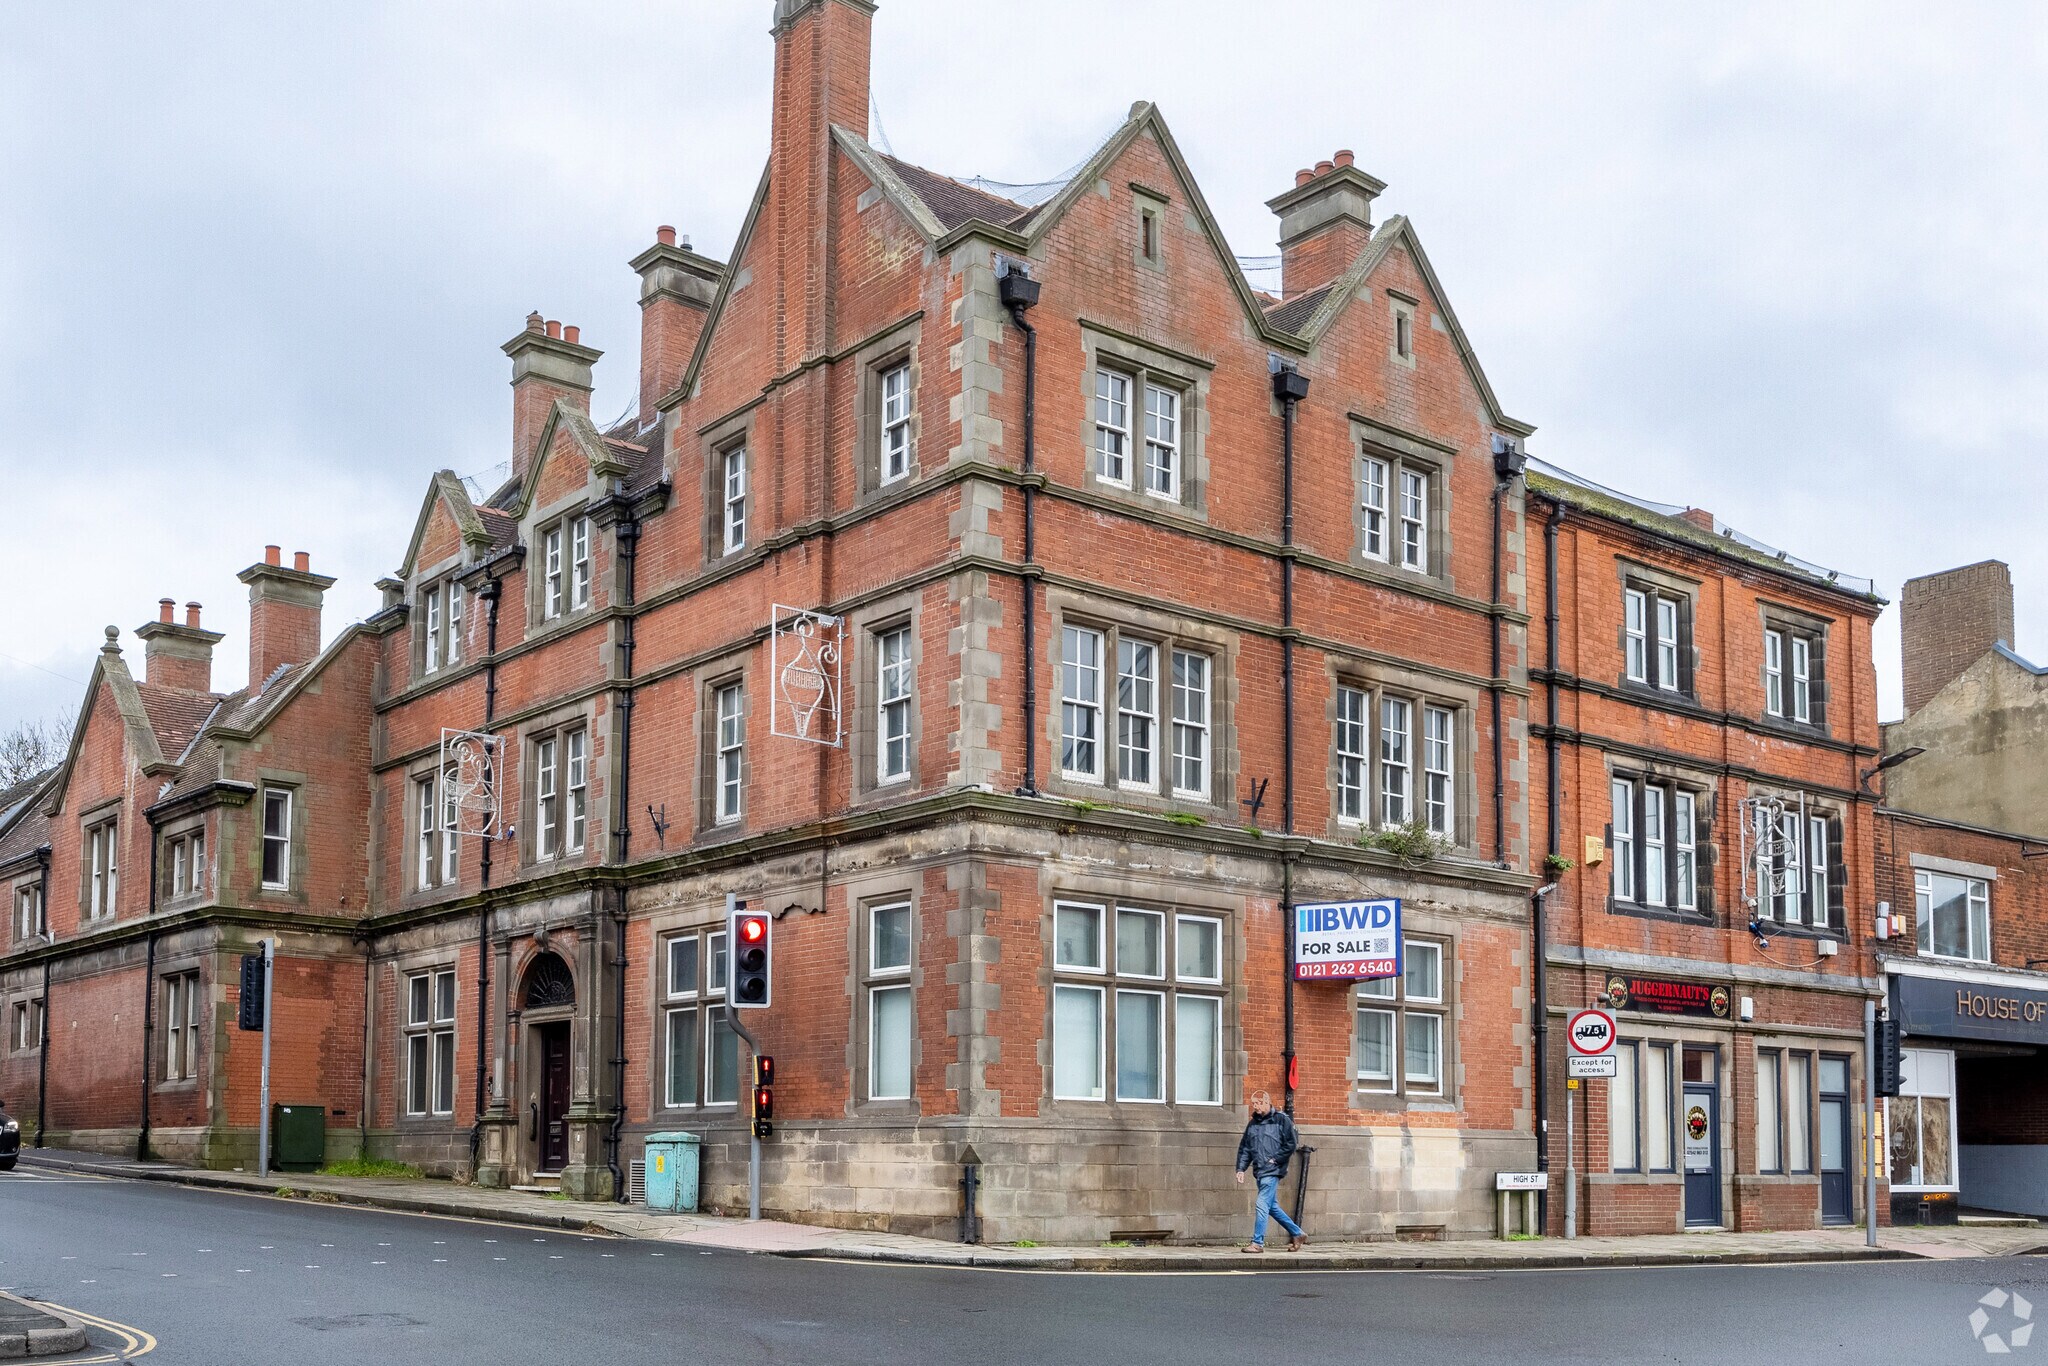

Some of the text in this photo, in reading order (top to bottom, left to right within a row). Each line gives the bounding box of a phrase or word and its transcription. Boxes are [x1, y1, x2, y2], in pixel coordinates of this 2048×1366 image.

[1302, 940, 1370, 955] FOR SALE
[1299, 961, 1393, 976] 0121 262 6540
[1629, 980, 1709, 1001] JUGGERNAUT'S
[1956, 989, 2047, 1022] HOUSE OF
[1513, 1175, 1539, 1183] HIGH ST
